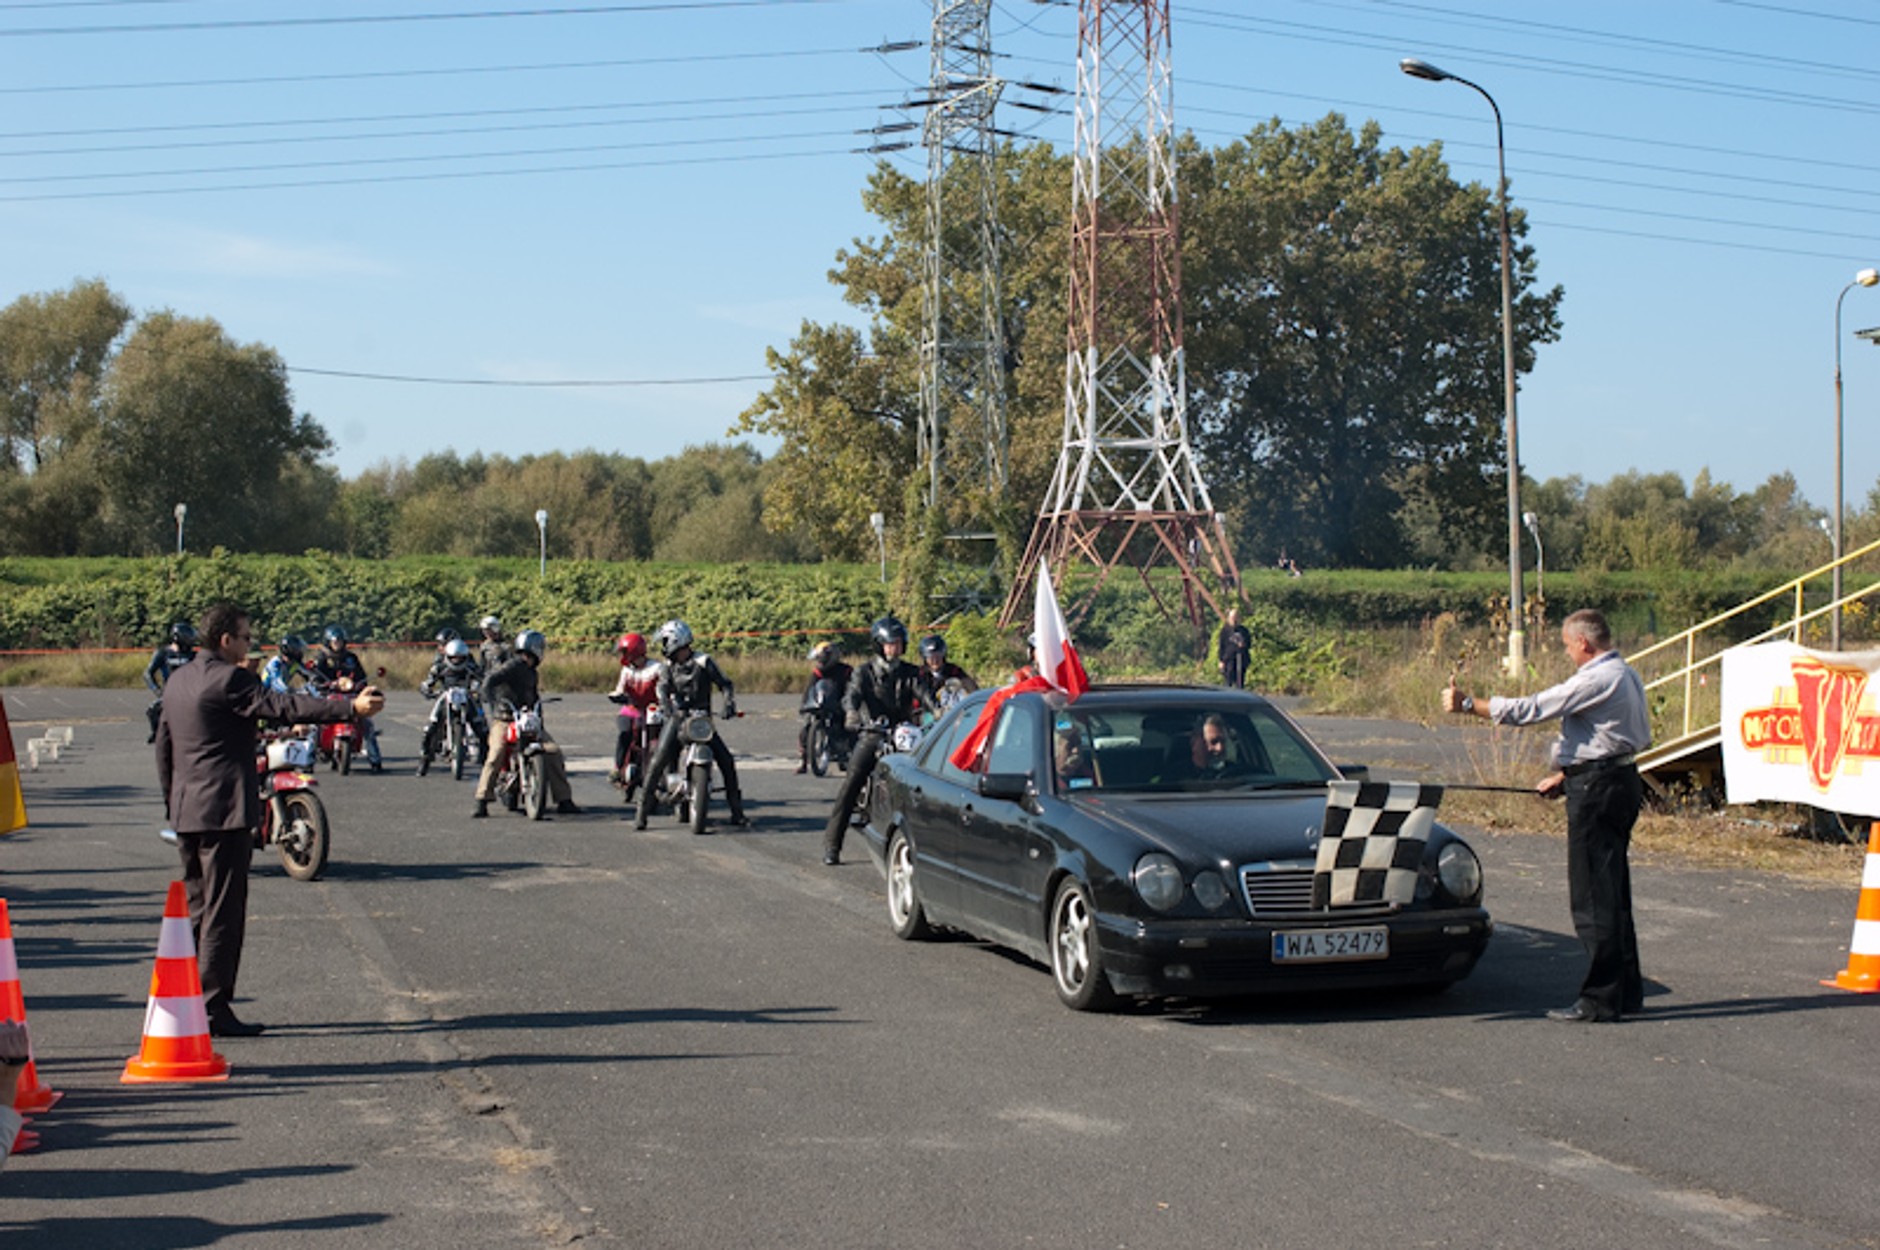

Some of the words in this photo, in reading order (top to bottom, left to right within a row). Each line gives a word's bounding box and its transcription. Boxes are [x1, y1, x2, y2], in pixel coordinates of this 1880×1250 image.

[898, 735, 917, 748] 27
[1287, 934, 1316, 955] WA
[1325, 932, 1384, 954] 52479
